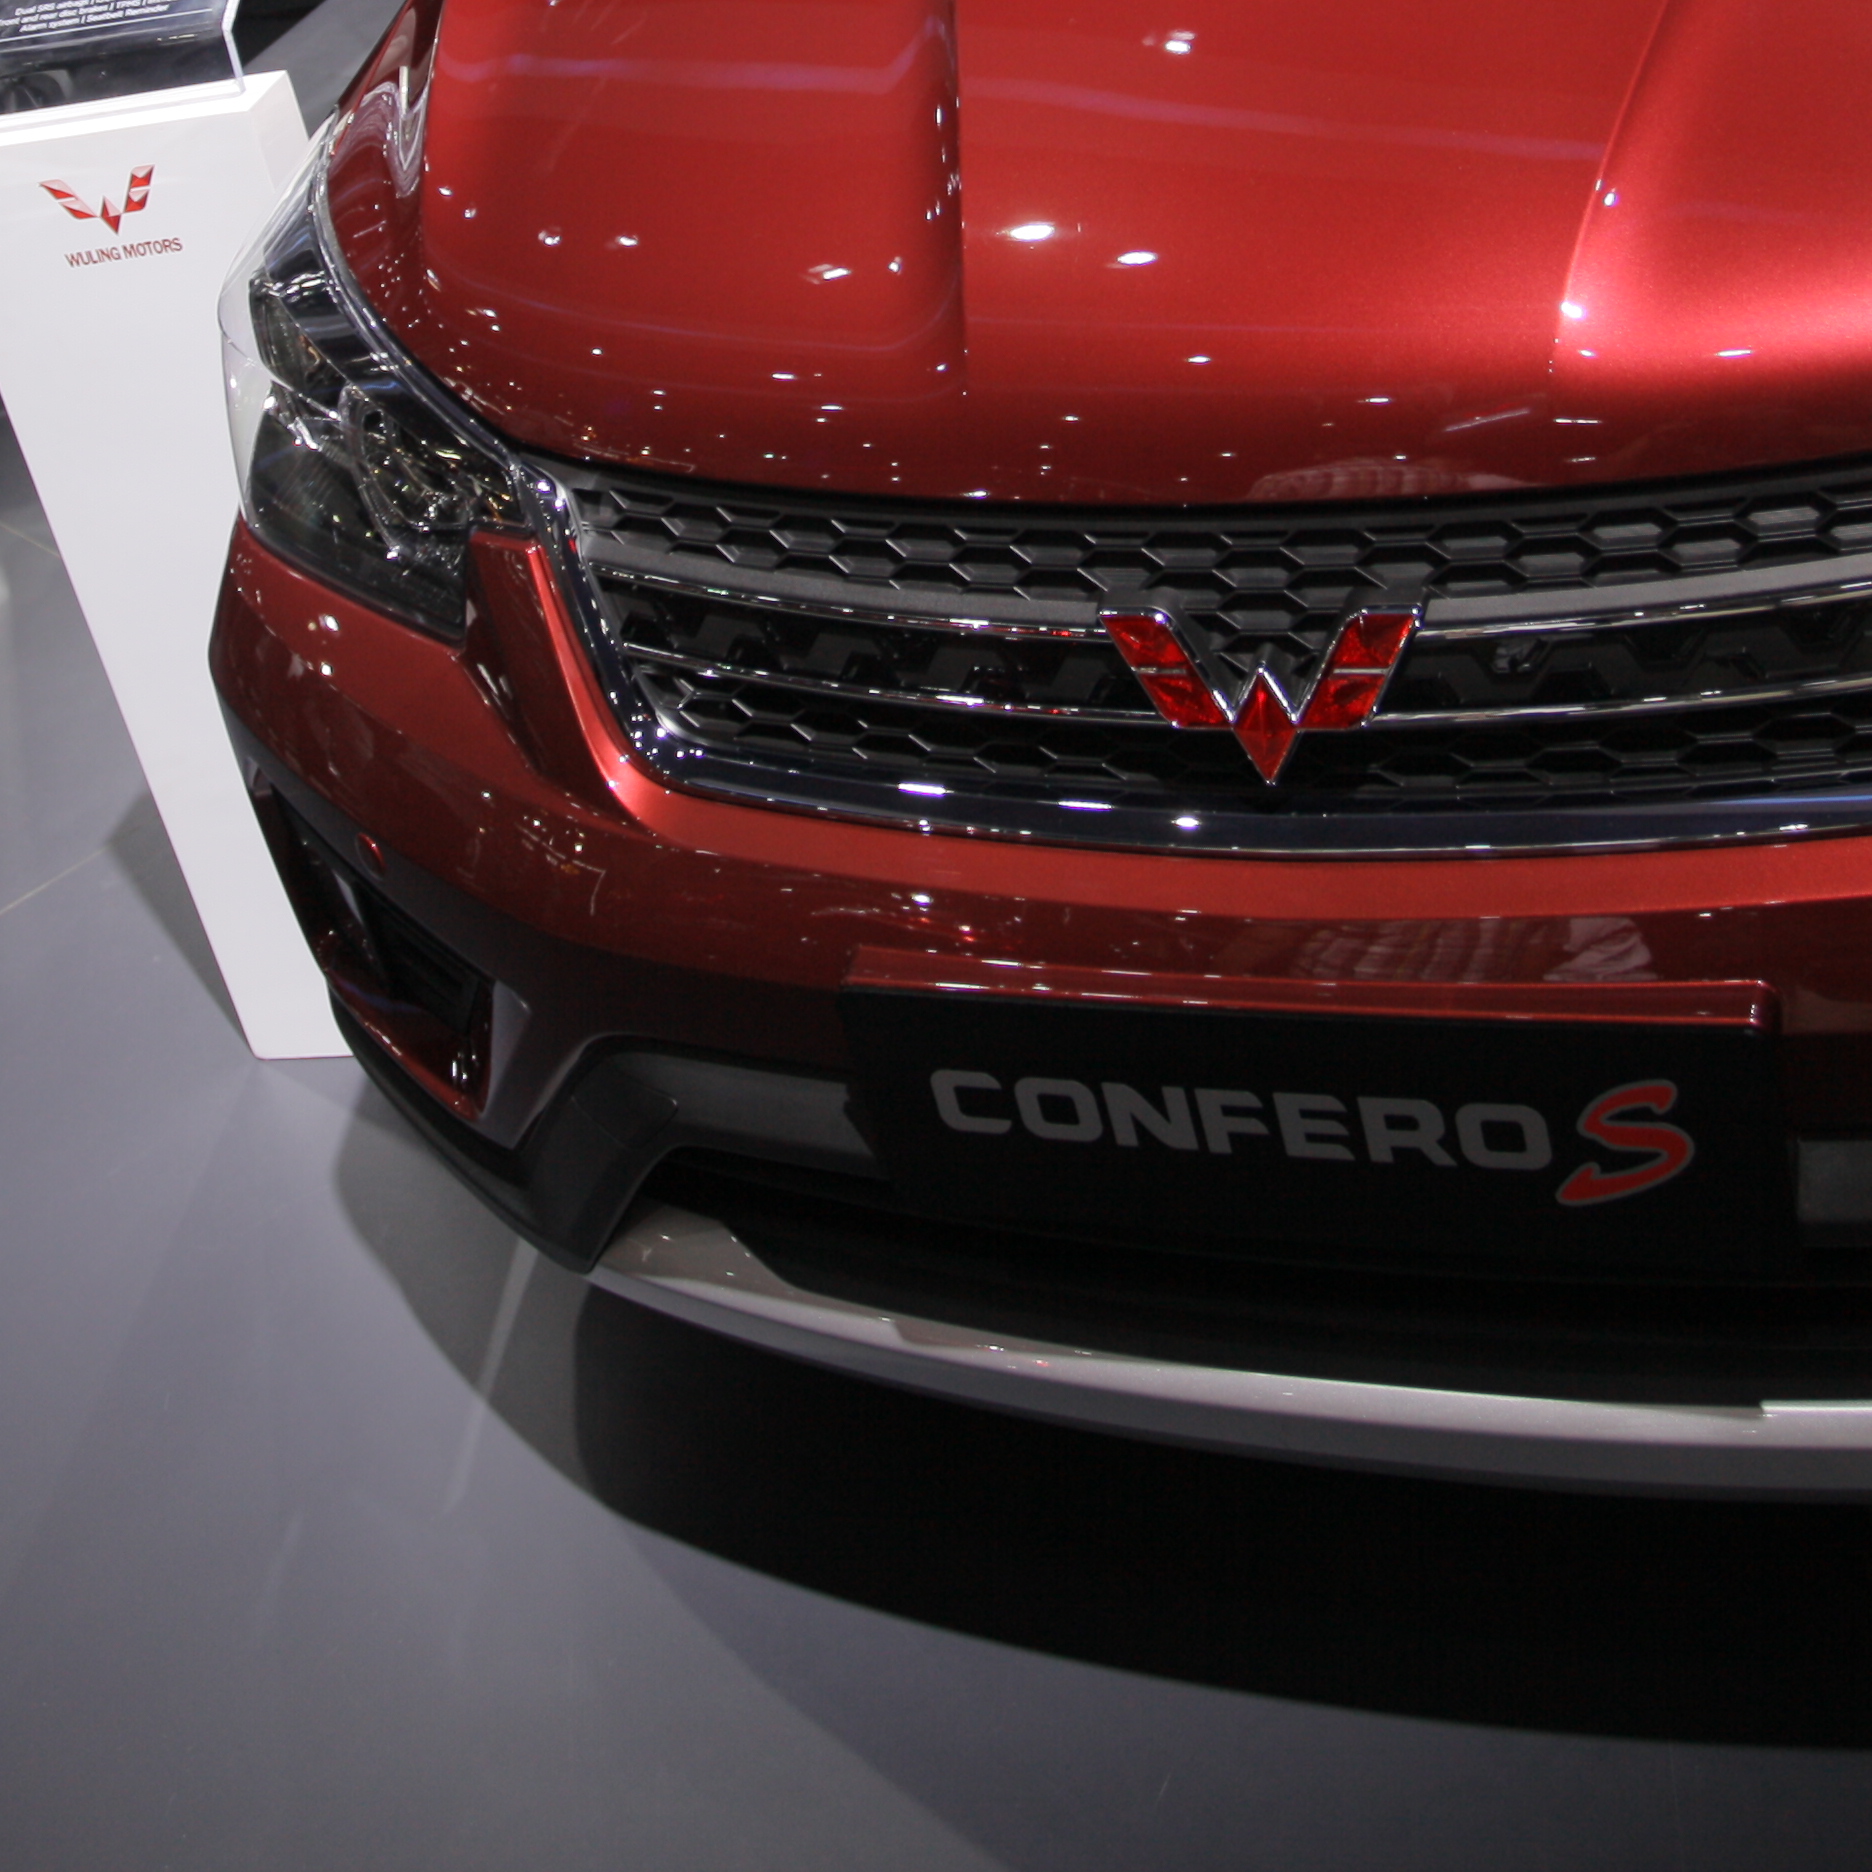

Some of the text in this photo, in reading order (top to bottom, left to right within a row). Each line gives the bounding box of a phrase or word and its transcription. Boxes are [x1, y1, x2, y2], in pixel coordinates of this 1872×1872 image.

[64, 237, 183, 268] WULING MOTORS
[930, 1069, 1695, 1206] CONFERO S
